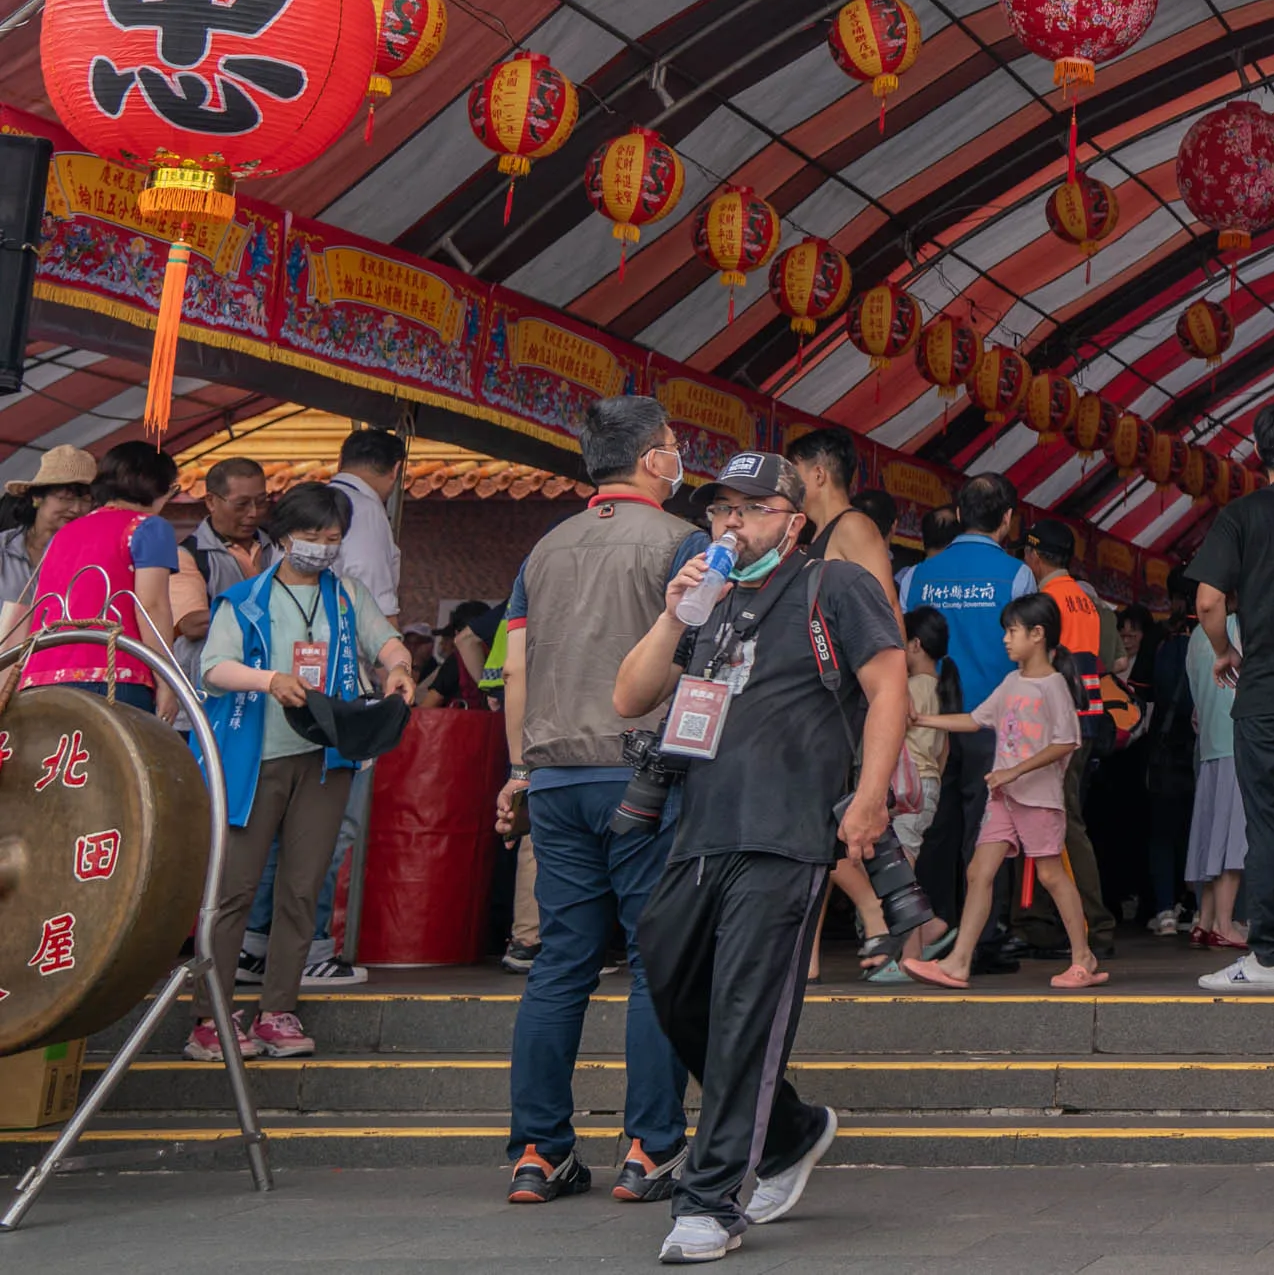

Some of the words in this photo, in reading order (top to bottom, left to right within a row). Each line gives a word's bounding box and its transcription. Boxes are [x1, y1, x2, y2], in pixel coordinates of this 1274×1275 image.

[921, 582, 995, 602] 新竹縣政府
[810, 620, 822, 634] 6D
[814, 634, 830, 661] EOS
